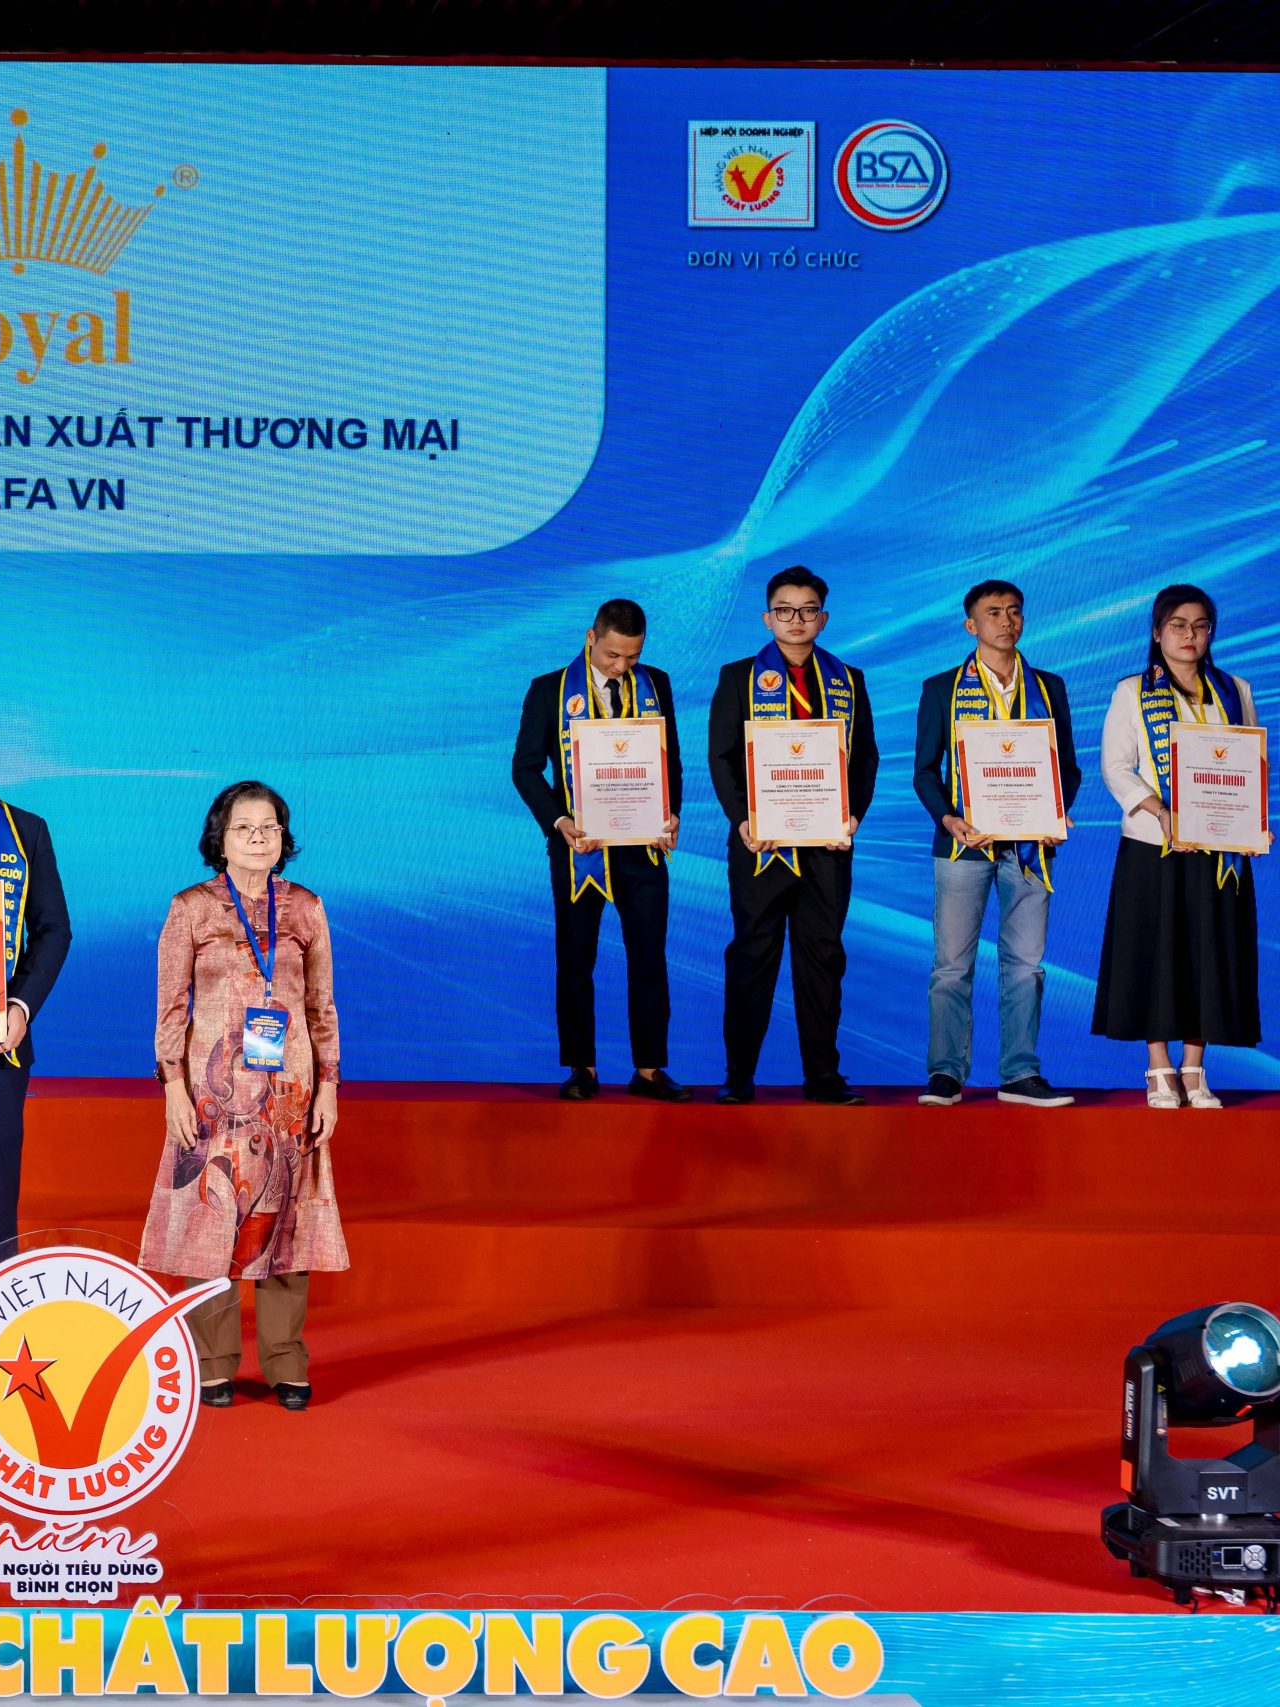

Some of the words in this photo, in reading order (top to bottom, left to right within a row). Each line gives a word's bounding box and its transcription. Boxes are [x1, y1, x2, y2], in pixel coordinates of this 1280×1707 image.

[739, 128, 770, 136] DOANH
[856, 151, 930, 183] BSA
[688, 250, 732, 267] ĐƠN
[742, 251, 761, 270] VỊ
[770, 246, 797, 267] TỔ
[805, 248, 860, 268] CHỨC
[45, 407, 163, 448] XUẤT
[177, 416, 368, 450] THƯƠNG
[383, 418, 458, 461] MẠI
[67, 478, 125, 510] VN
[754, 703, 785, 712] DOANH
[956, 699, 988, 710] NGHIỆP
[1157, 754, 1169, 763] CH
[0, 853, 17, 863] DO
[65, 1269, 143, 1321] NAM
[68, 1424, 167, 1500] LƯỢNG
[154, 1346, 181, 1414] CAO
[1207, 1486, 1239, 1501] SVT
[3, 1560, 60, 1576] NGƯỜI
[65, 1560, 102, 1576] TIÊU
[108, 1560, 158, 1576] DÙNG
[17, 1577, 59, 1593] BÌNH
[65, 1580, 113, 1597] CHỌN
[254, 1610, 652, 1707] LƯỢNG
[662, 1612, 886, 1699] CAO
